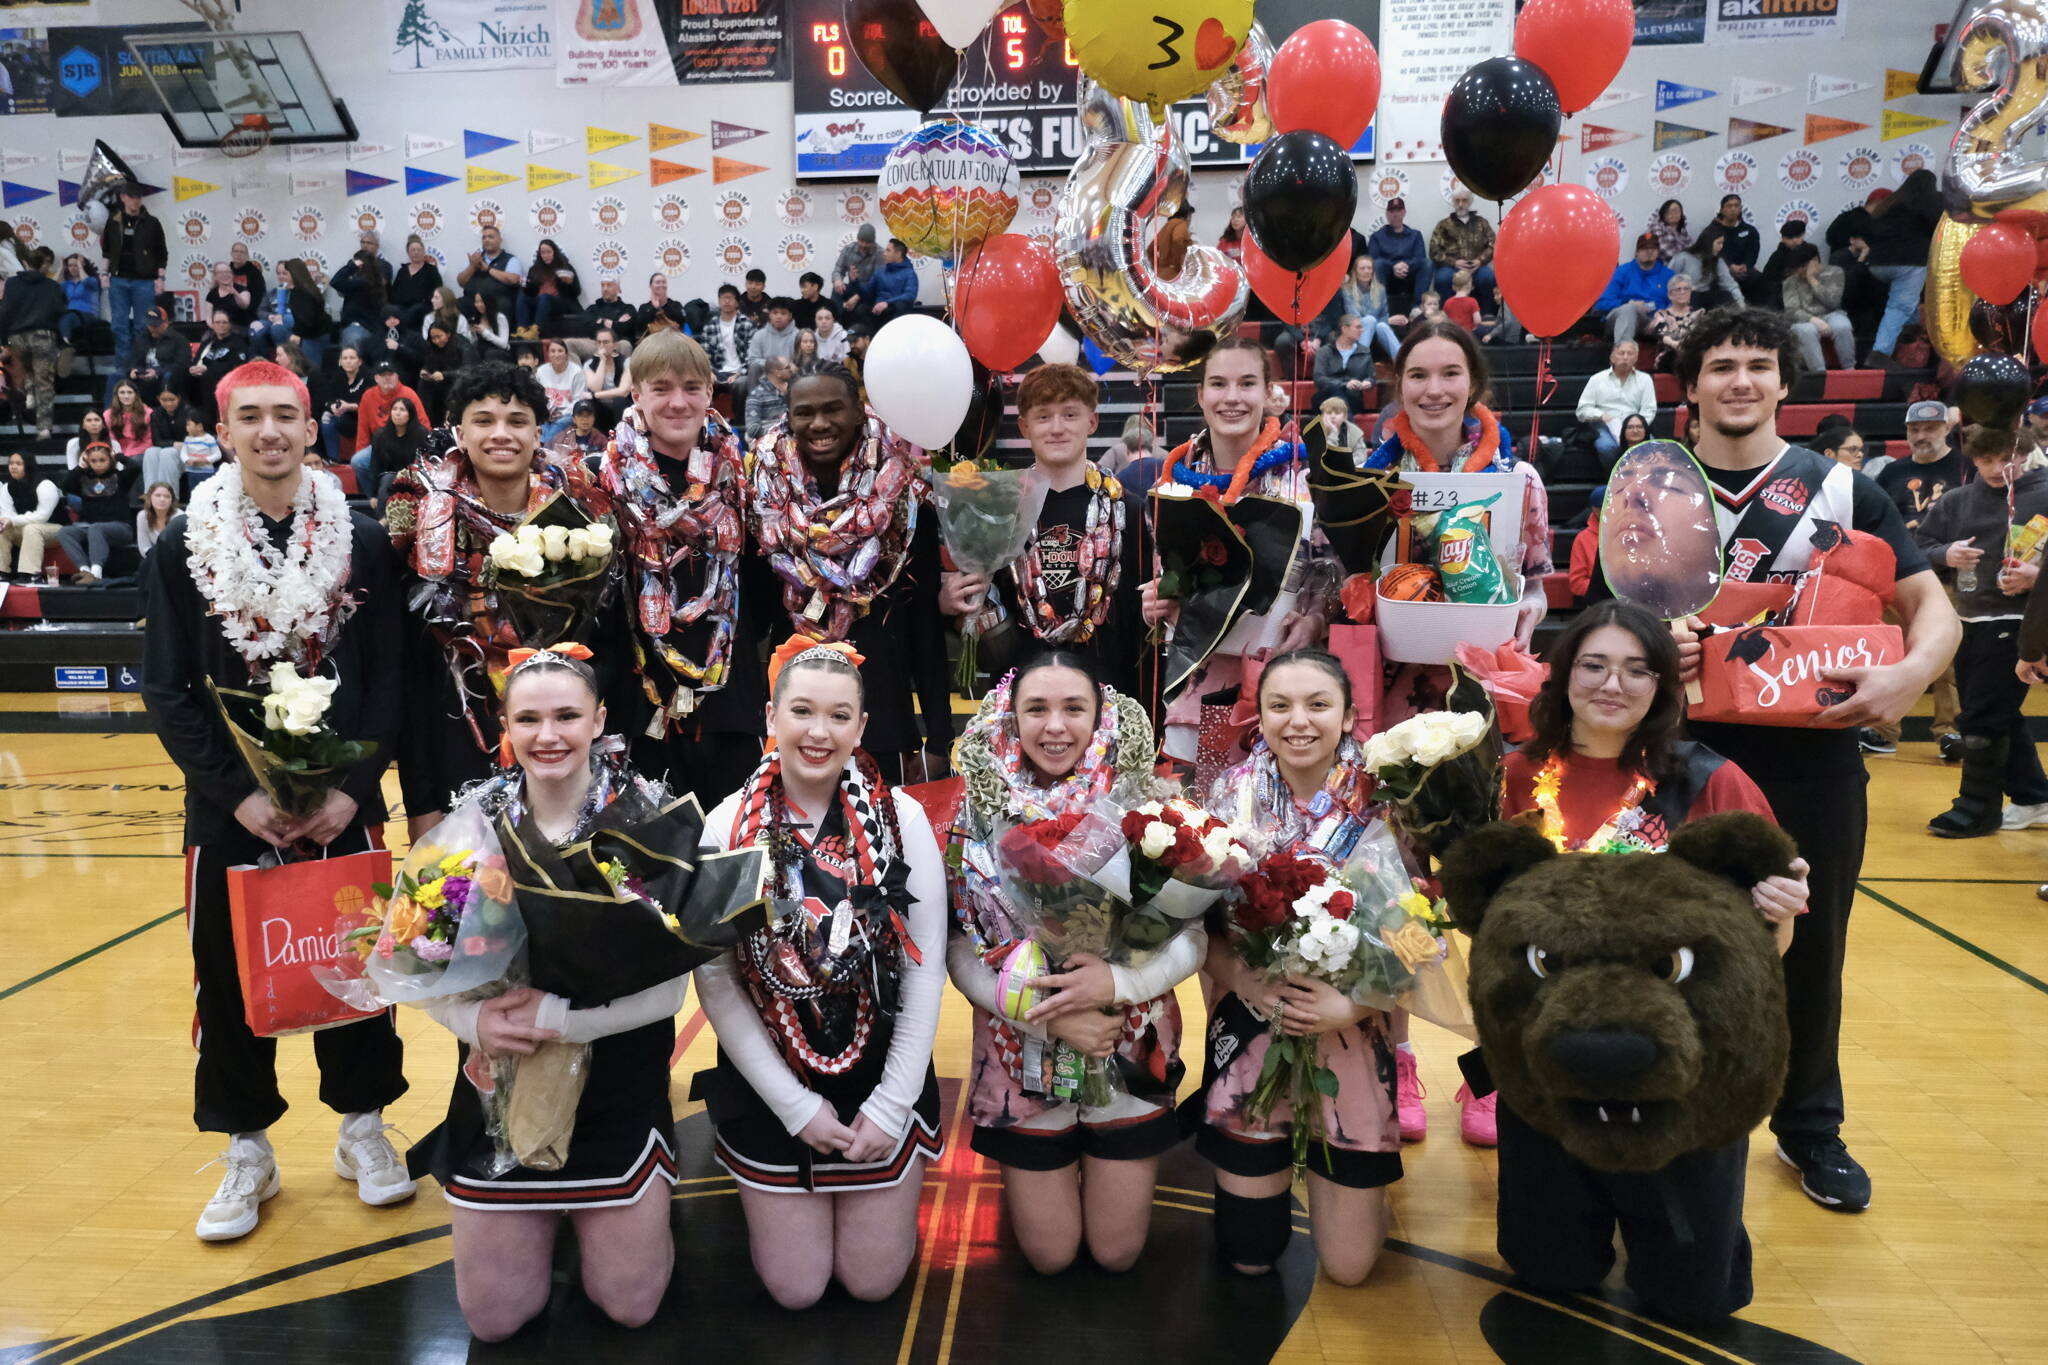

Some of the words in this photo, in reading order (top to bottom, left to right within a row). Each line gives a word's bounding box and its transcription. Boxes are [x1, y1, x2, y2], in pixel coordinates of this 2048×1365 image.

[681, 19, 710, 29] Proud
[712, 17, 765, 29] Supporters
[767, 15, 778, 25] of
[1002, 16, 1027, 34] TOL
[1633, 22, 1695, 37] OLLEYBALL
[1717, 21, 1768, 32] PRINT
[1784, 18, 1837, 28] MEDIA
[479, 21, 550, 45] Nizich
[679, 33, 716, 43] Alaskan
[719, 31, 783, 42] Communities
[813, 24, 839, 42] FLS
[436, 47, 487, 61] FAMILY
[492, 46, 551, 58] DENTAL
[569, 50, 604, 60] Building
[608, 49, 640, 58] Alaska
[643, 48, 656, 57] for
[828, 46, 845, 76] 0
[1007, 38, 1024, 69] 5
[64, 63, 97, 79] SJR
[120, 66, 149, 77] JUN
[577, 62, 597, 70] over
[601, 60, 618, 69] 100
[623, 61, 648, 69] Years
[949, 80, 1033, 106] provided
[1040, 81, 1063, 104] by
[826, 119, 865, 138] Don't
[855, 133, 874, 142] PLAY
[877, 132, 885, 140] IT
[886, 129, 904, 139] COOL
[1042, 115, 1083, 159] FU
[1667, 156, 1690, 171] CHAMP
[1733, 153, 1756, 168] CHAMP
[1796, 151, 1820, 166] CHAMP
[1856, 148, 1881, 164] CHAMP
[886, 159, 1009, 187] CONGRATULATIONS
[1604, 158, 1626, 173] CHAMP
[1386, 168, 1408, 183] CHAMP
[1780, 175, 1818, 190] KETCHIKAN
[850, 187, 872, 202] CHAMP
[1038, 180, 1060, 195] CHAMP
[1720, 180, 1752, 194] JUNEAU
[667, 194, 688, 209] CHAMP
[729, 192, 750, 207] CHAMP
[790, 188, 811, 203] CHAMP
[363, 204, 383, 219] CHAMP
[422, 203, 442, 218] CHAMP
[481, 200, 503, 215] CHAMP
[544, 198, 564, 214] CHAMP
[604, 197, 625, 211] CHAMP
[1776, 203, 1794, 223] STATE
[1799, 200, 1818, 223] CHAMP
[190, 208, 209, 225] CHAMP
[245, 208, 266, 223] CHAMP
[304, 206, 324, 221] CHAMP
[782, 213, 809, 225] JUNEAU
[841, 212, 869, 224] JUNEAU
[534, 224, 561, 236] JUNEAU
[595, 222, 622, 233] JUNEAU
[656, 220, 684, 231] JUNEAU
[719, 217, 748, 228] JUNEAU
[592, 242, 608, 261] STATE
[610, 241, 628, 261] CHAMP
[654, 240, 670, 259] STATE
[672, 239, 691, 259] CHAMP
[716, 237, 730, 257] STATE
[733, 236, 752, 257] CHAMP
[779, 235, 793, 254] STATE
[796, 234, 813, 254] CHAMP
[310, 251, 328, 270] CHAMP
[428, 247, 446, 267] CHAMP
[720, 263, 747, 274] JUNEAU
[1413, 490, 1459, 508] #23
[1760, 489, 1805, 513] STEFANO
[1458, 581, 1478, 592] Onion
[1460, 574, 1481, 584] Cream
[1750, 637, 1884, 707] Senior
[262, 917, 342, 967] Damia
